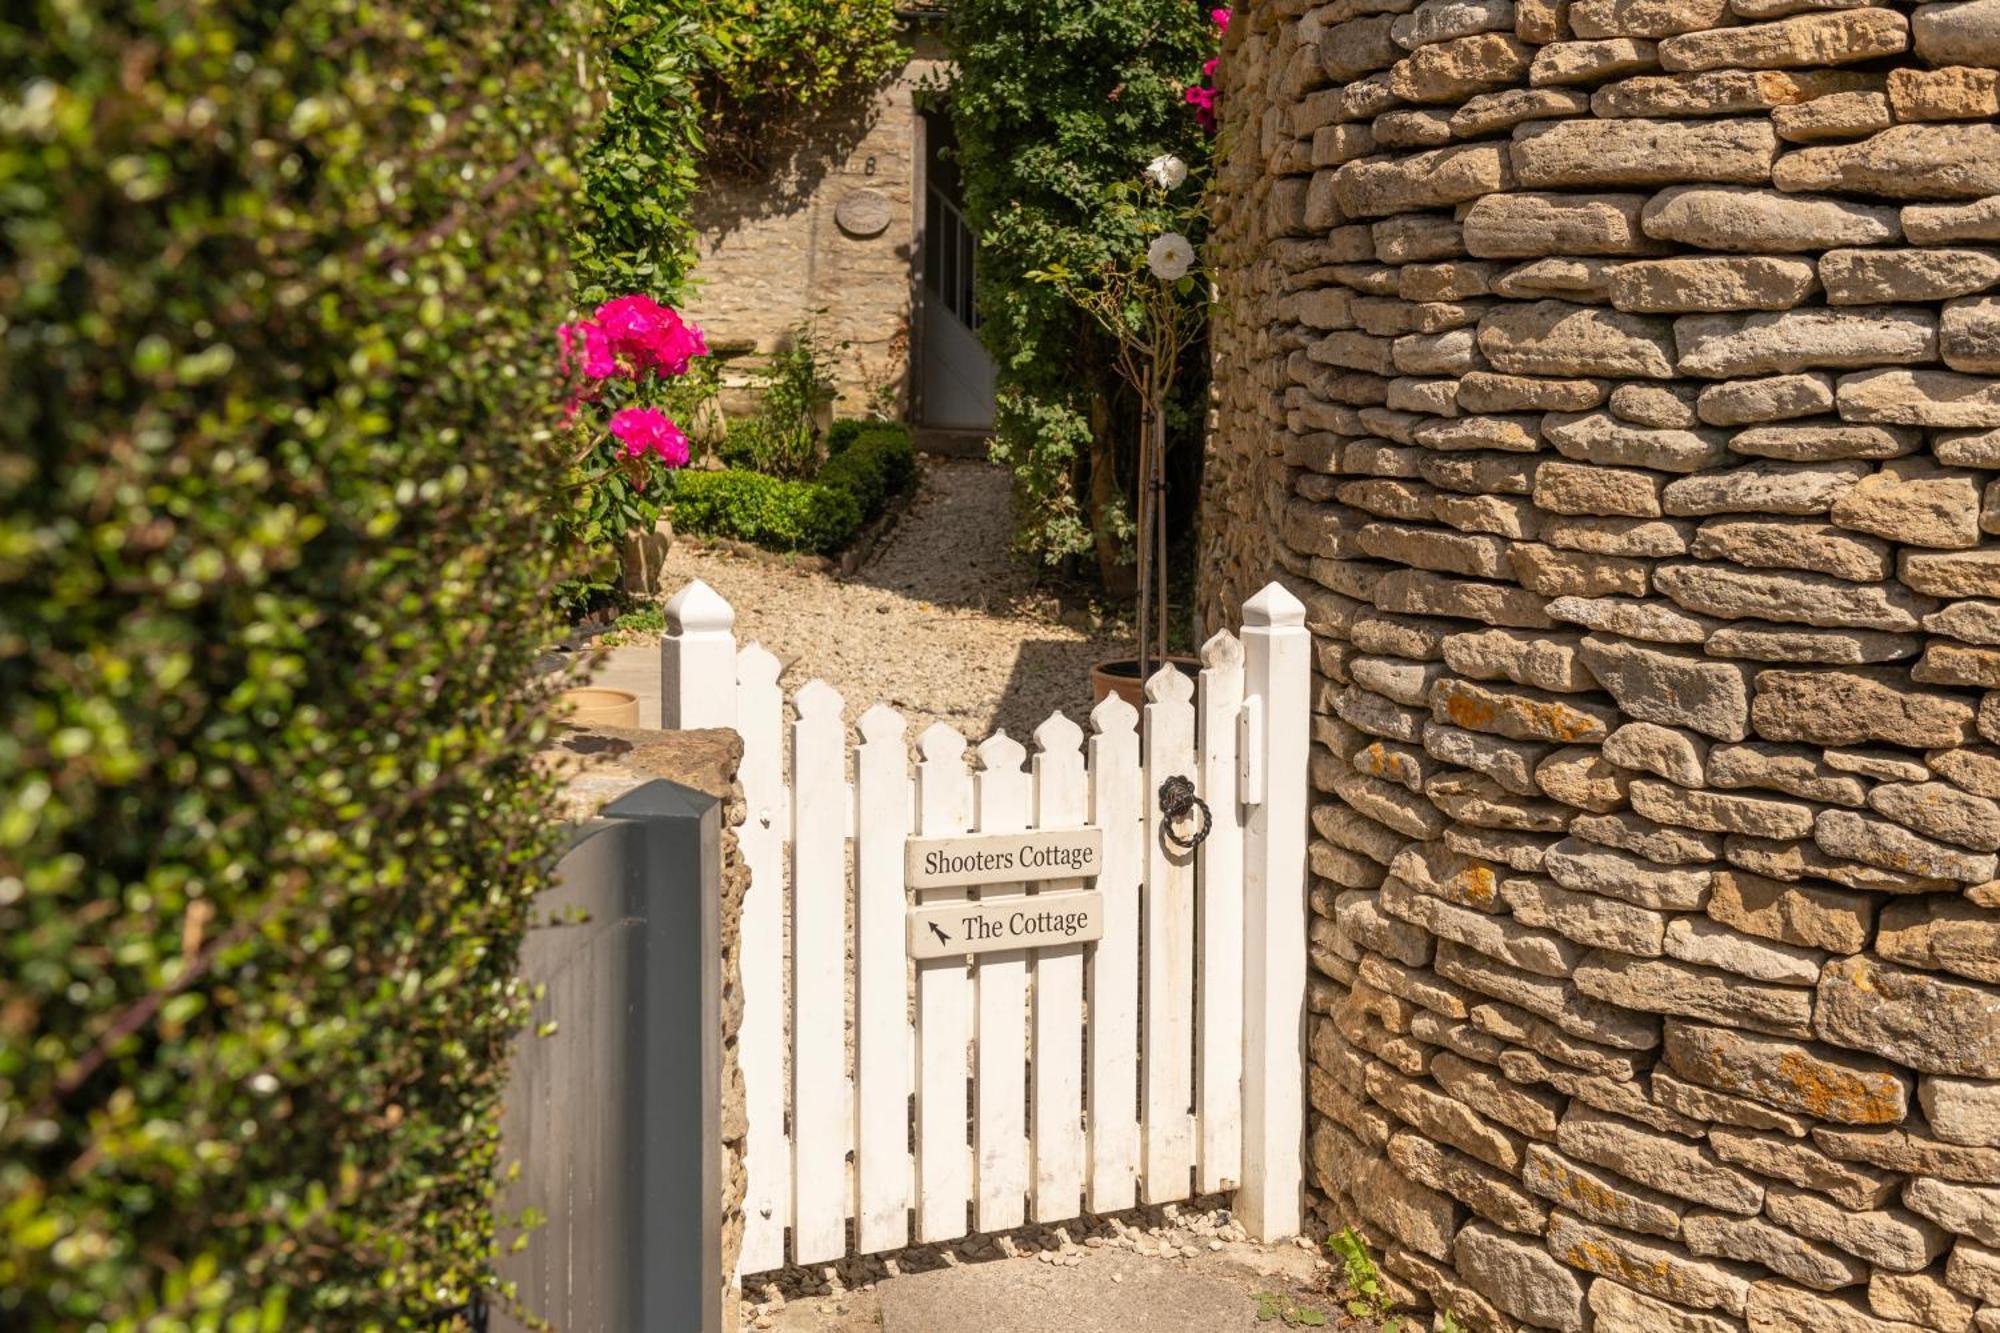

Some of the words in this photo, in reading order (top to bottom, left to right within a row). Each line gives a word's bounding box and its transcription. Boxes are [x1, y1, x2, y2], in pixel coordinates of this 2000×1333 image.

[864, 156, 876, 176] 8
[925, 851, 1013, 874] Shooters
[1019, 846, 1093, 869] Cottage
[962, 915, 1003, 940] The
[1009, 912, 1088, 936] Cottage
